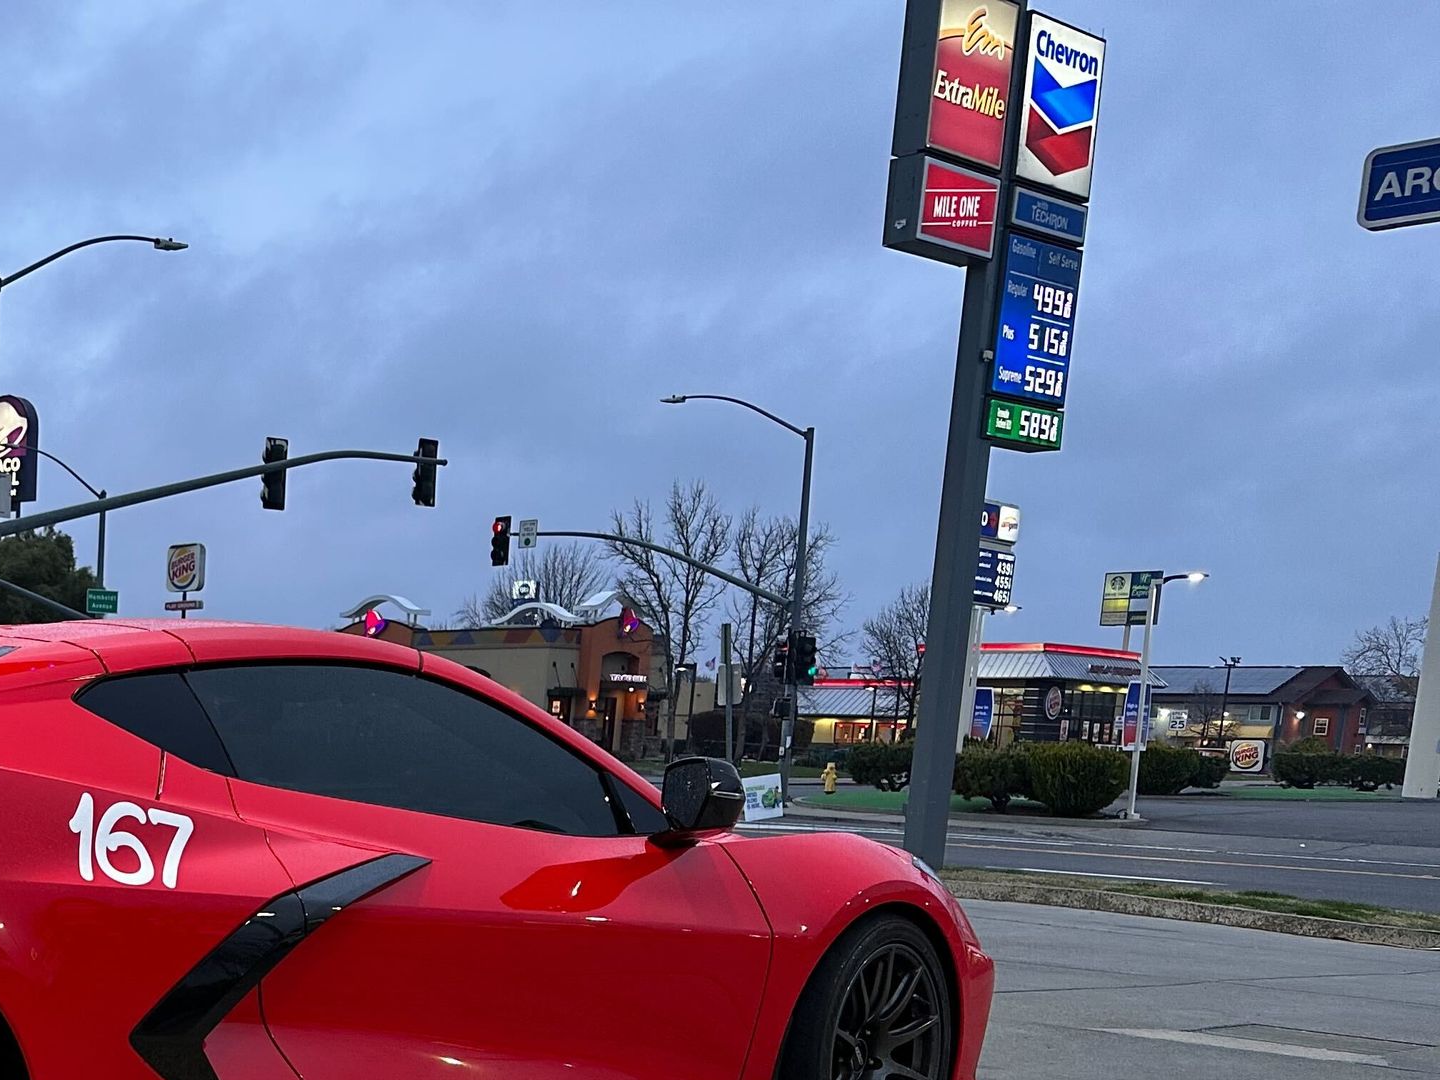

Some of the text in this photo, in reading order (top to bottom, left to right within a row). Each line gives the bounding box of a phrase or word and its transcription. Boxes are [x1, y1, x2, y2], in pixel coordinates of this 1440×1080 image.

[1036, 29, 1099, 77] Chevron
[933, 69, 1005, 120] ExtraMile
[933, 195, 981, 218] MILE ONE
[951, 219, 978, 228] COFFEE
[1031, 205, 1069, 231] TECHRON
[1012, 239, 1037, 259] Gasoline
[1048, 251, 1079, 271] Self Serve
[1007, 279, 1029, 298] Regular
[1002, 324, 1015, 341] Plus
[998, 365, 1023, 384] Supreme
[172, 560, 196, 581] KING
[1170, 720, 1185, 729] 25
[1234, 746, 1259, 756] BURGER
[1235, 751, 1259, 764] KING
[69, 792, 194, 889] 167
